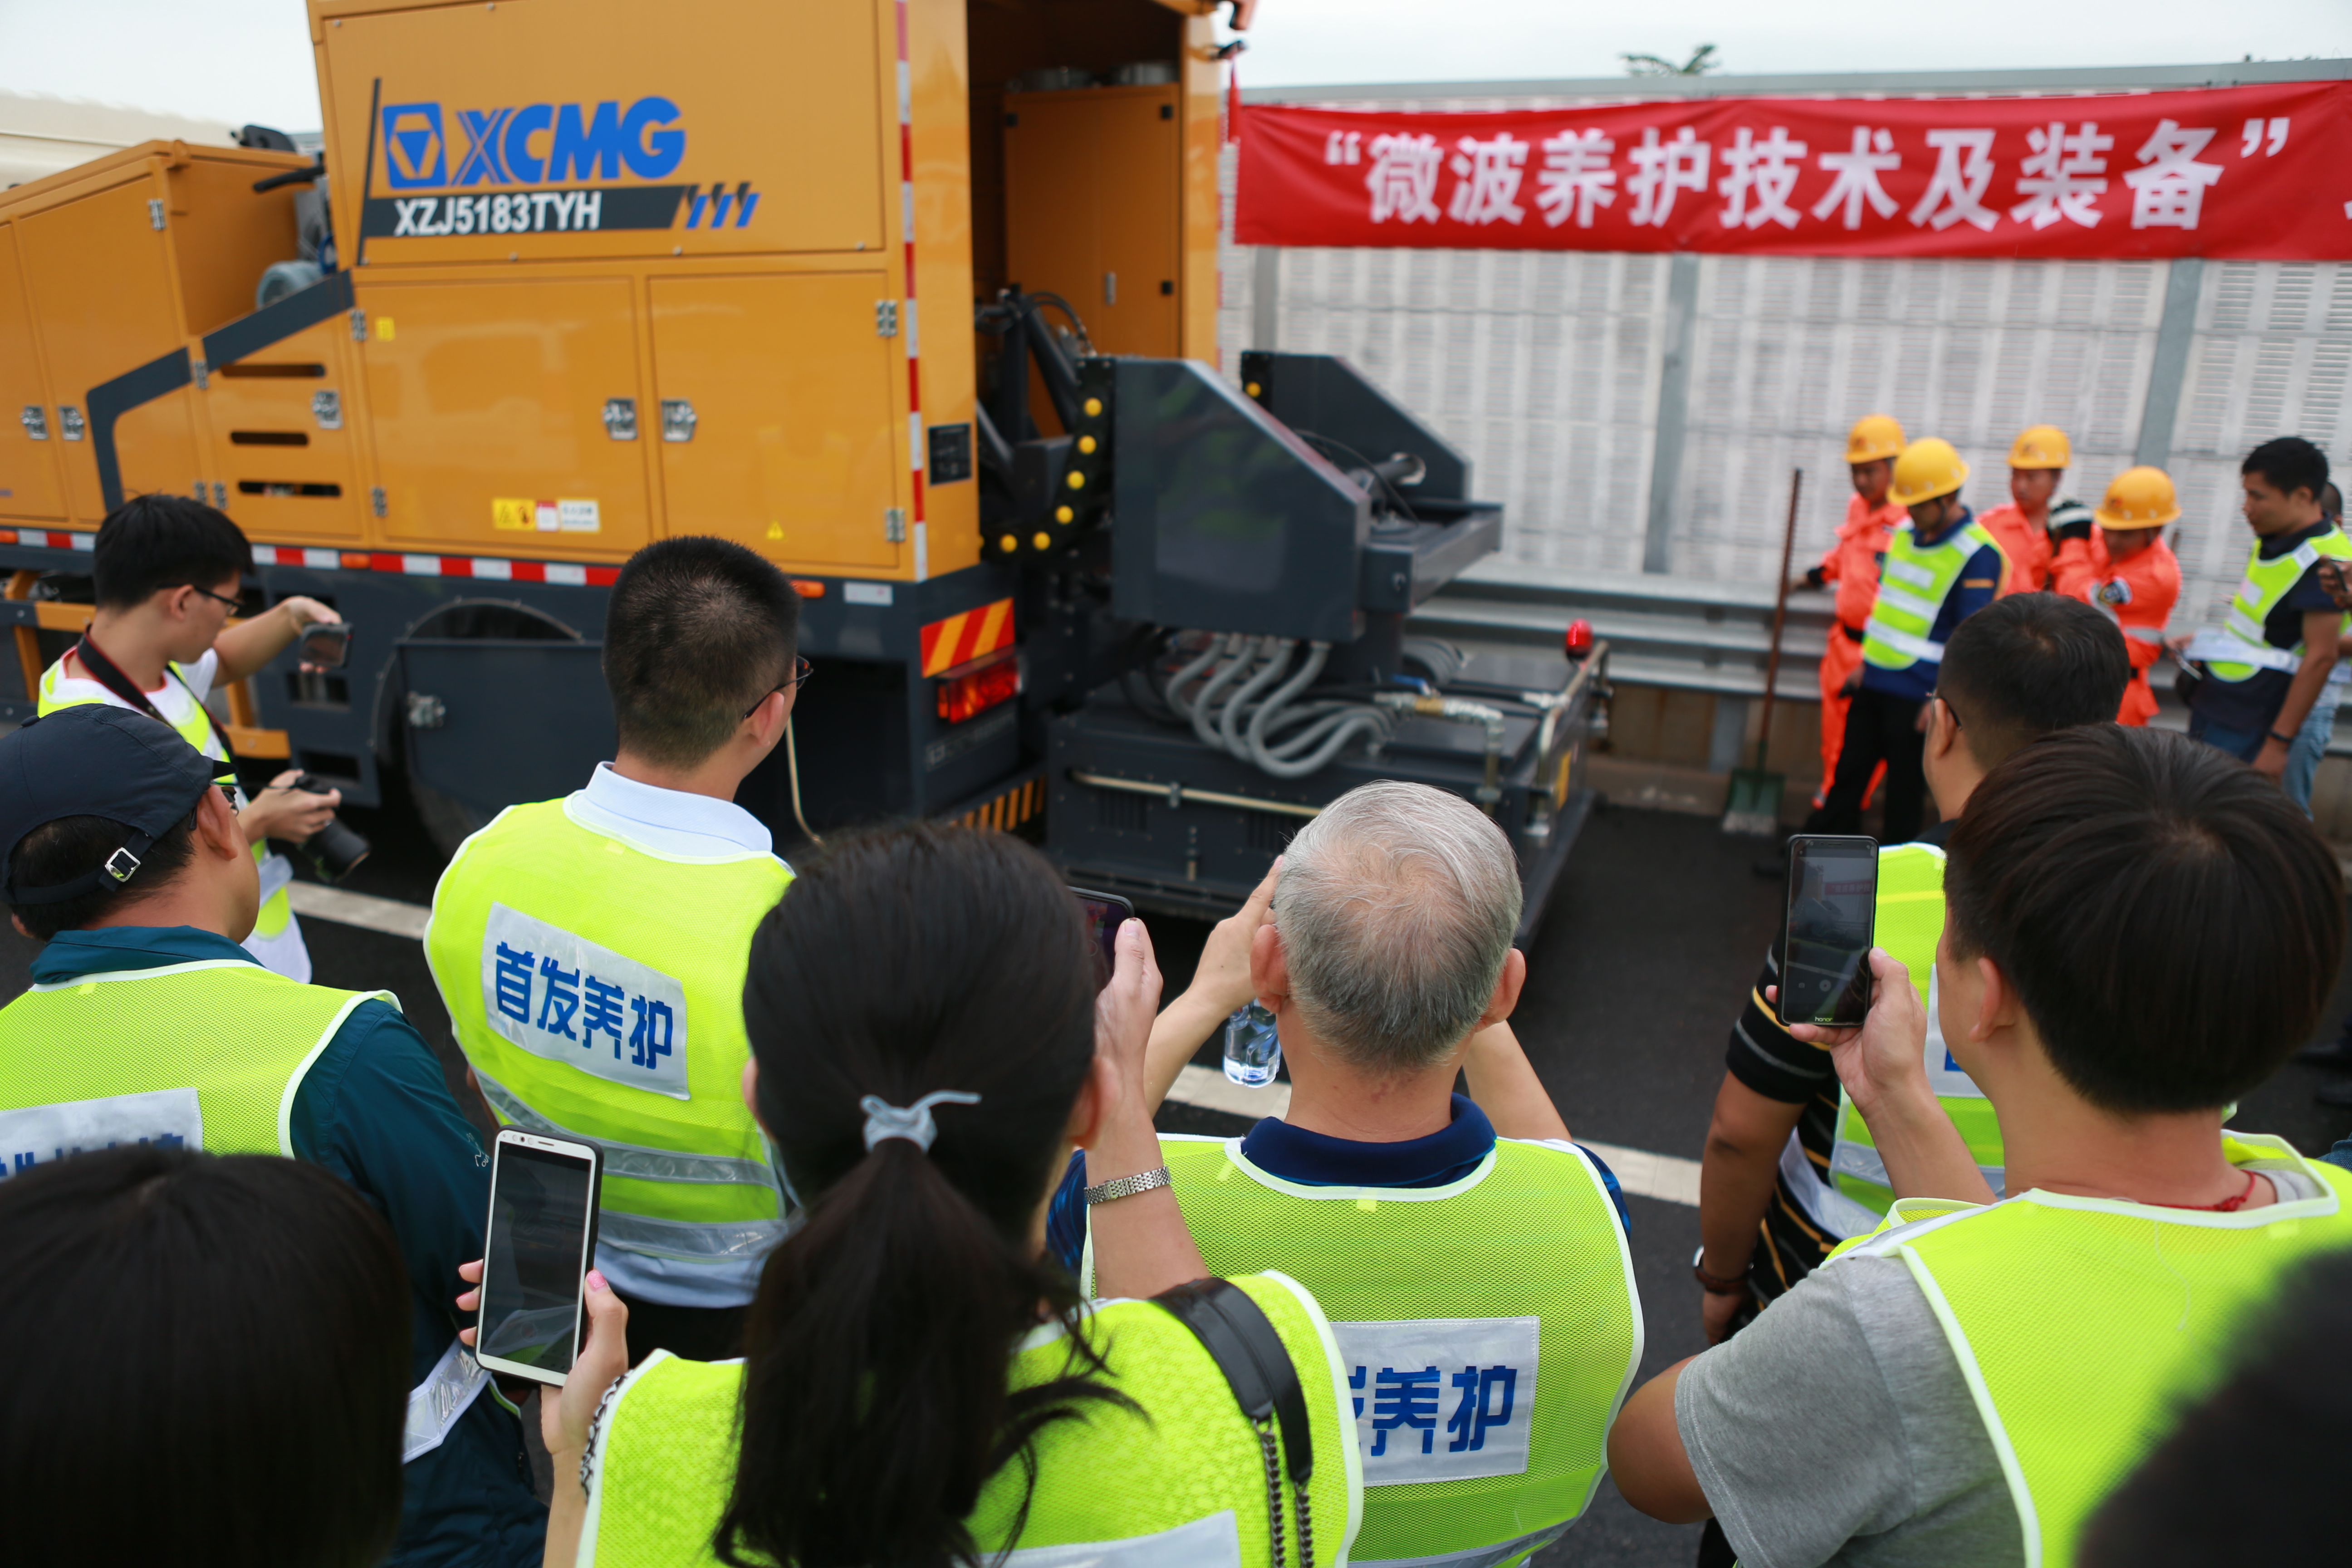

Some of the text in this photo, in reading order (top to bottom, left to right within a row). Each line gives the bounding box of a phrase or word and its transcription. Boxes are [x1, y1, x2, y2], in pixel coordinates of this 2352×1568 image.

[451, 96, 686, 186] XCMG
[1324, 117, 2352, 232] “微波养护技术及装备”
[394, 191, 602, 236] XZJ5183TYH
[495, 941, 673, 1070] 首发养护
